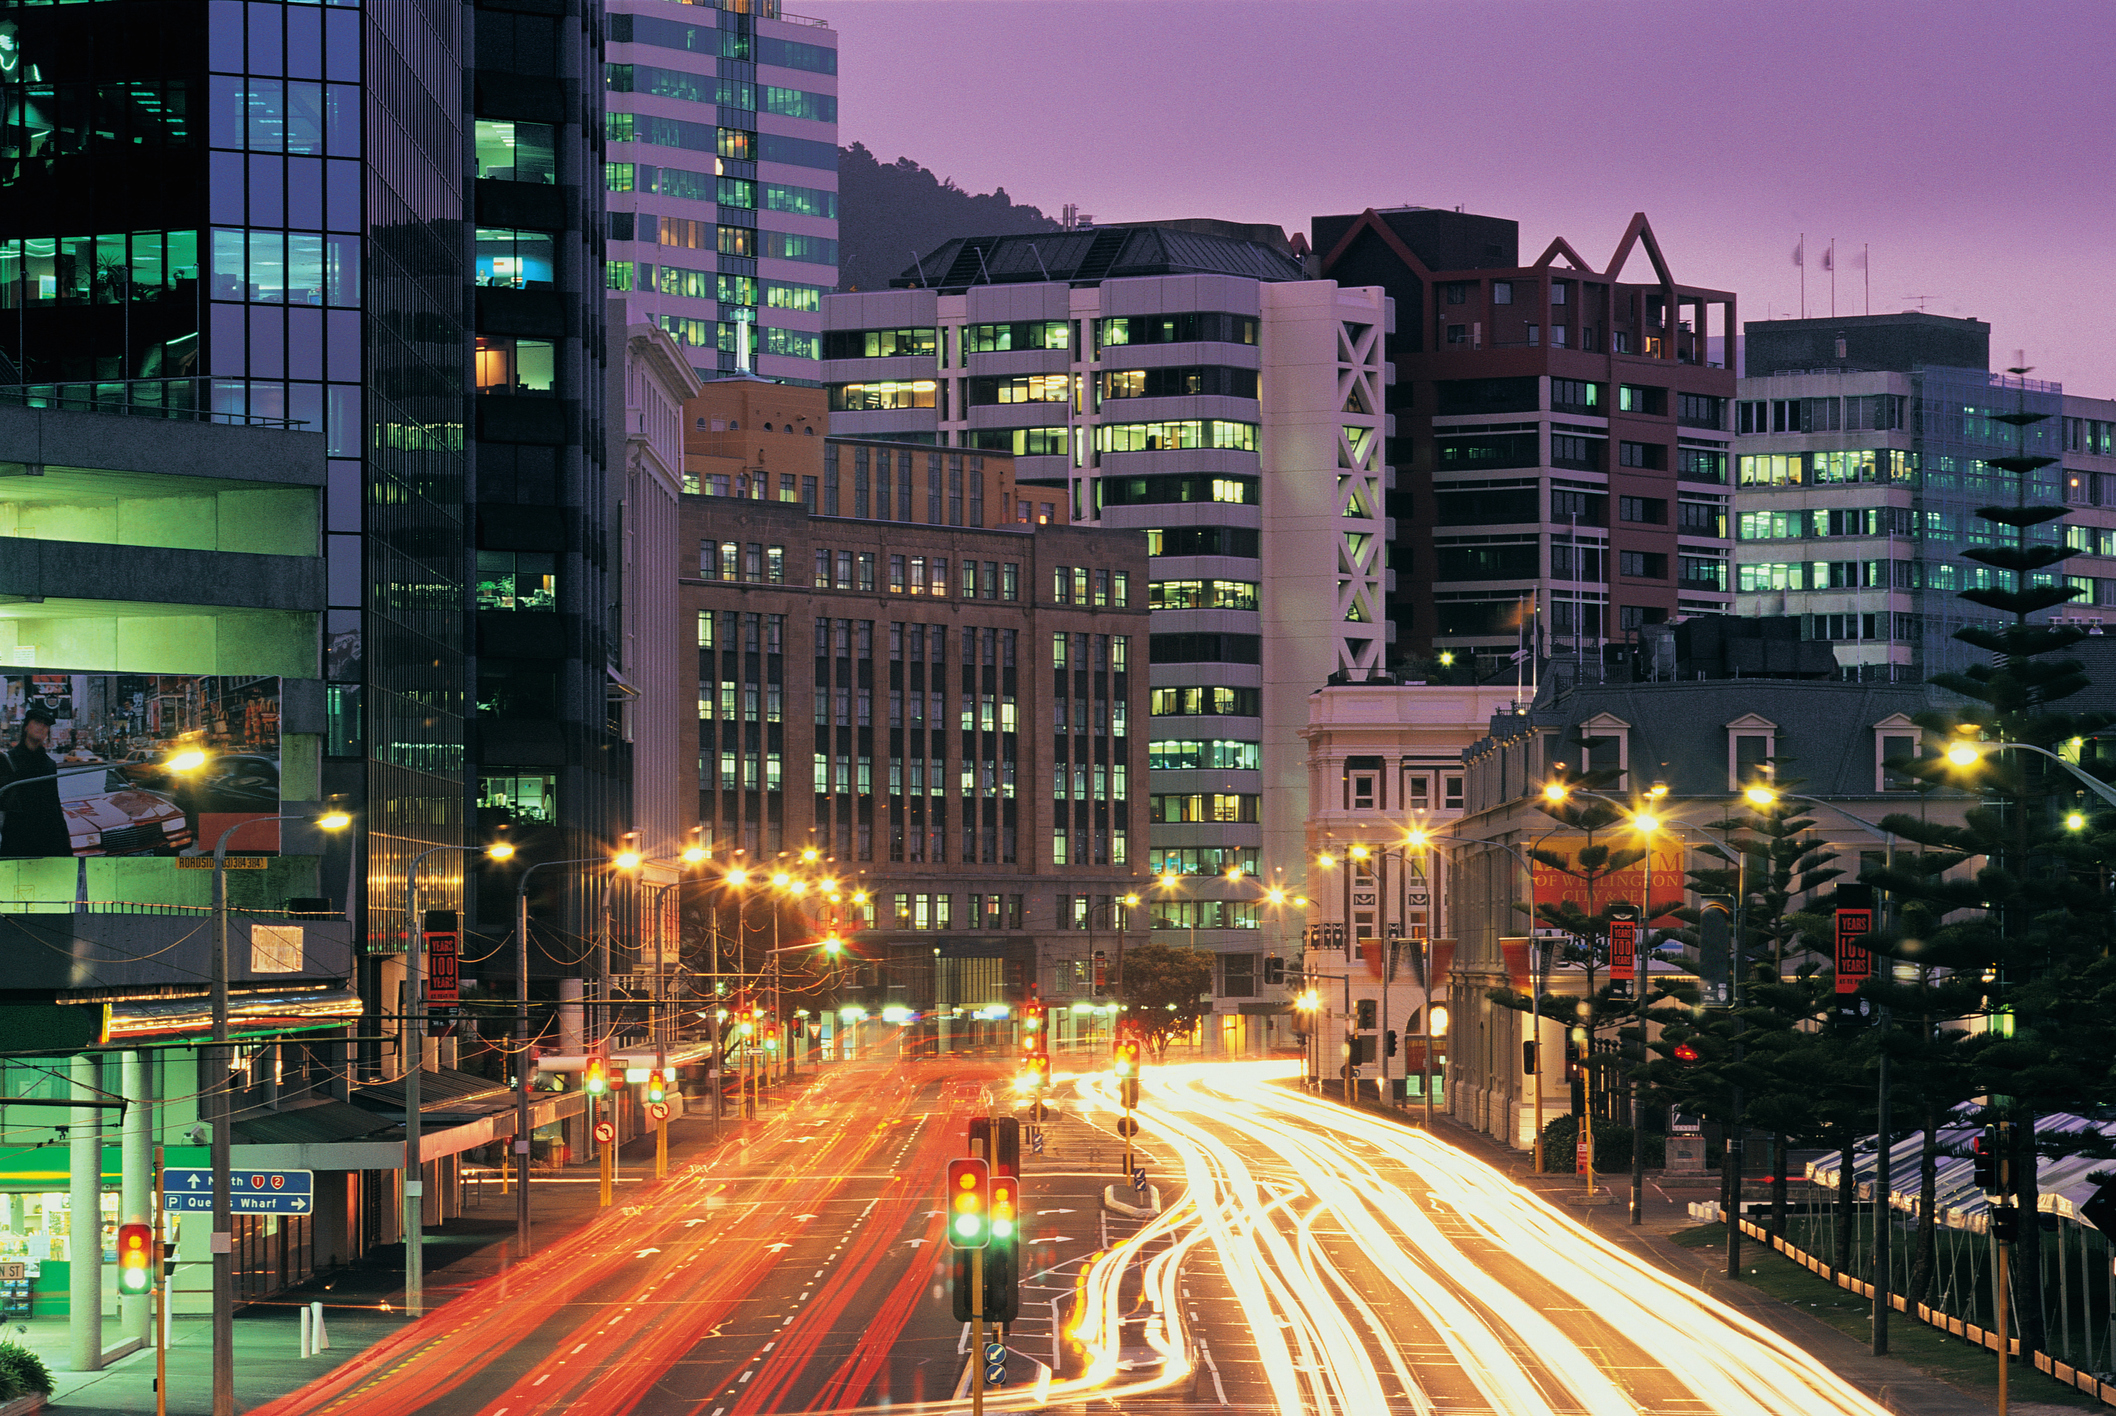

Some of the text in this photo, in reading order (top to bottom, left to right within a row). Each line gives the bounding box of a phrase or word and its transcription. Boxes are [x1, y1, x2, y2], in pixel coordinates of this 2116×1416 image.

[179, 857, 215, 869] ROADSID
[1535, 874, 1679, 887] OF WELINGON
[1562, 890, 1645, 902] CITY & SE
[1842, 918, 1867, 930] YEARS
[1614, 929, 1631, 938] YEARS
[432, 940, 454, 952] YEARS
[1614, 941, 1631, 955] 100
[432, 957, 454, 976] 100
[1614, 956, 1631, 965] YEARS
[1842, 959, 1866, 972] YEARS
[433, 977, 454, 988] YEARS
[208, 1176, 243, 1187] Nth
[274, 1177, 281, 1186] 2
[168, 1196, 277, 1208] P Ques Wharf
[9, 1266, 20, 1277] ST
